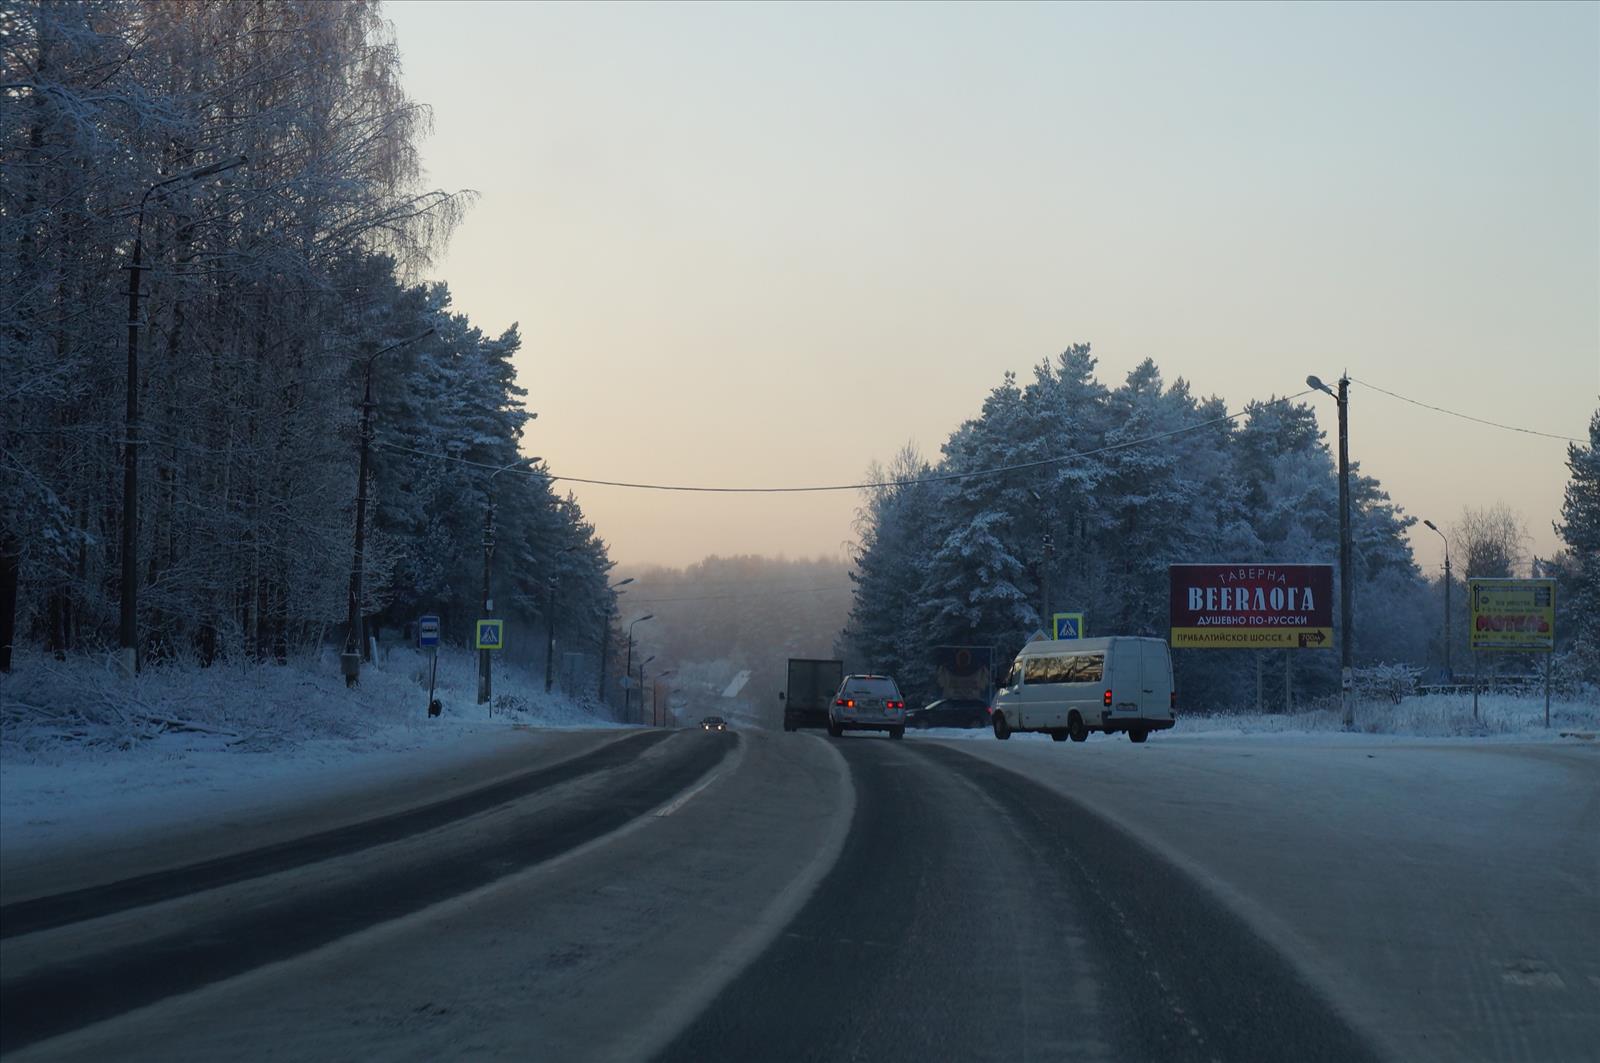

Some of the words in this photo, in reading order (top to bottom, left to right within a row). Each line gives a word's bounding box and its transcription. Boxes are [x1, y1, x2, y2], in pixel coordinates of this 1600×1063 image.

[1219, 568, 1287, 585] ТАВЕРНА
[1198, 615, 1246, 626] ДУШЕВНО
[1249, 615, 1307, 625] ПО-РУССКИ
[1177, 632, 1247, 642] ПРИБАЛТИЙСКОЕ
